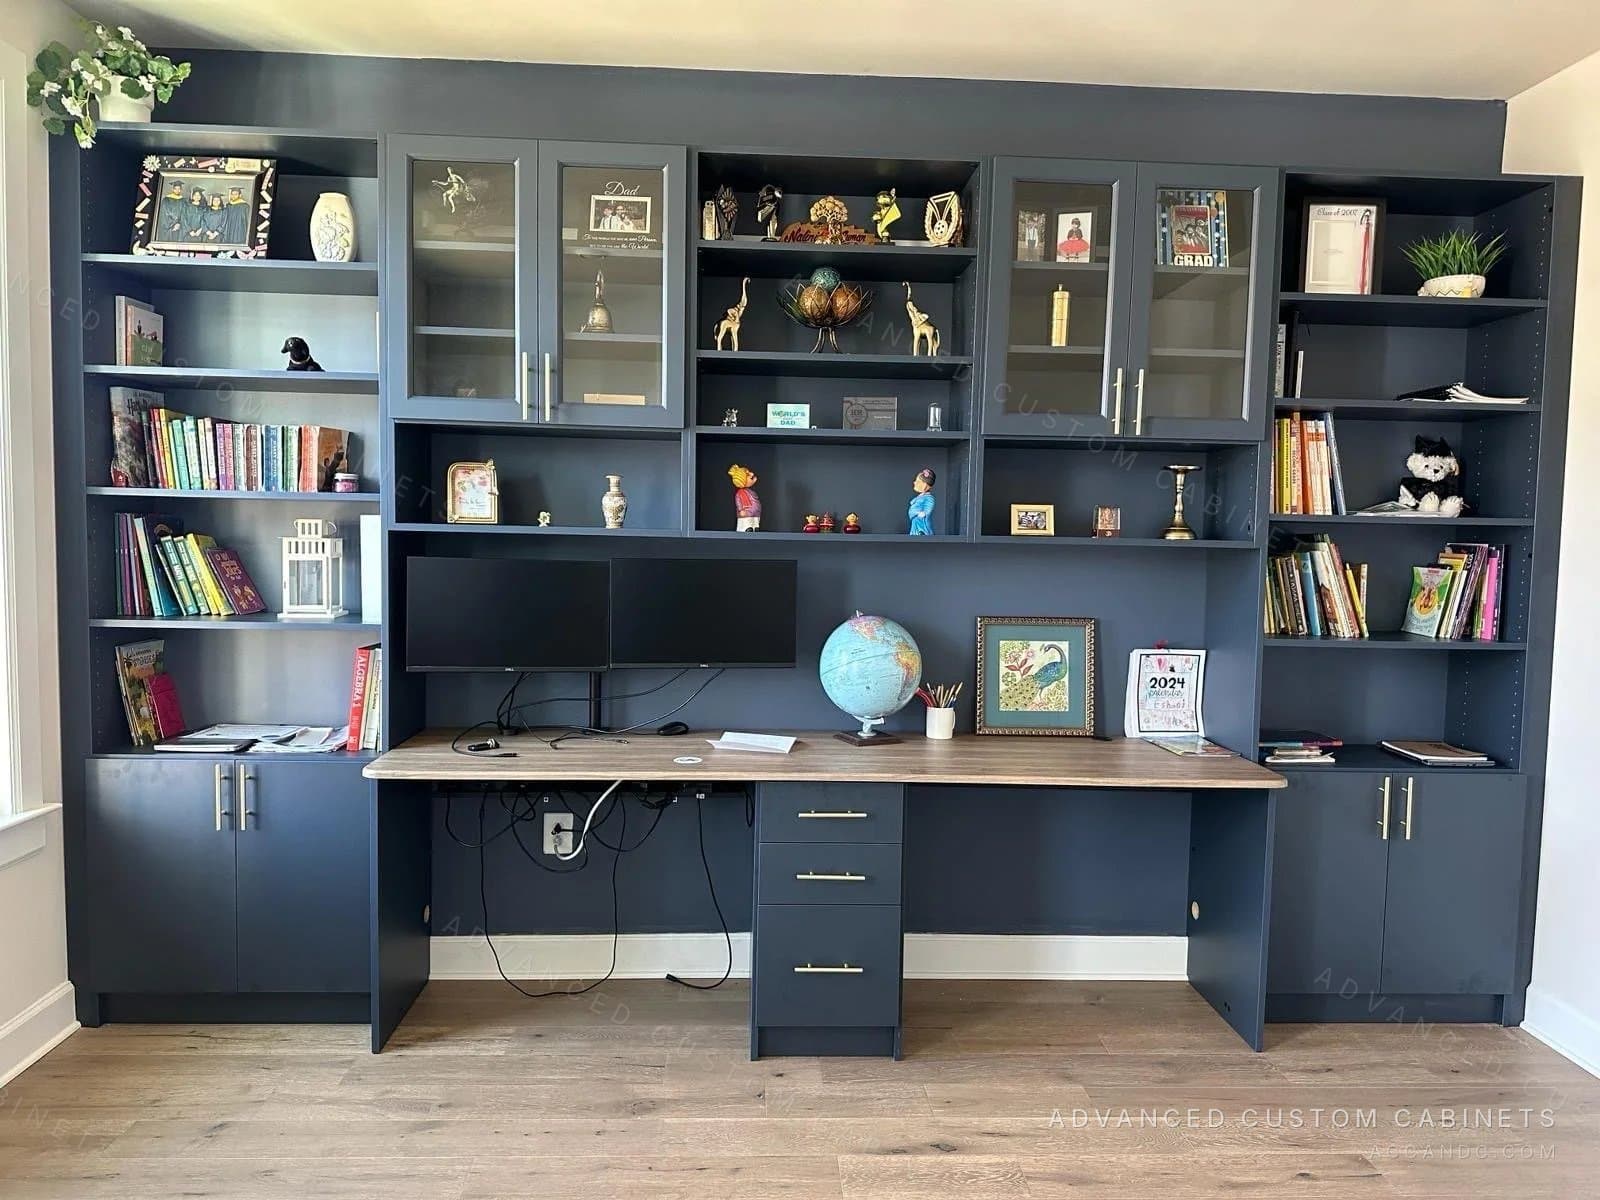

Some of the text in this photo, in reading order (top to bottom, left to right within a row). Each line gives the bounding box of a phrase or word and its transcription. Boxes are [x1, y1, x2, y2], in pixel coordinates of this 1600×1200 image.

[604, 181, 640, 196] Dad
[1317, 208, 1331, 216] Class
[1174, 254, 1213, 267] GRAD
[772, 410, 806, 418] WORLD'S
[353, 655, 368, 701] ALGEBRA
[1149, 677, 1186, 689] 2024
